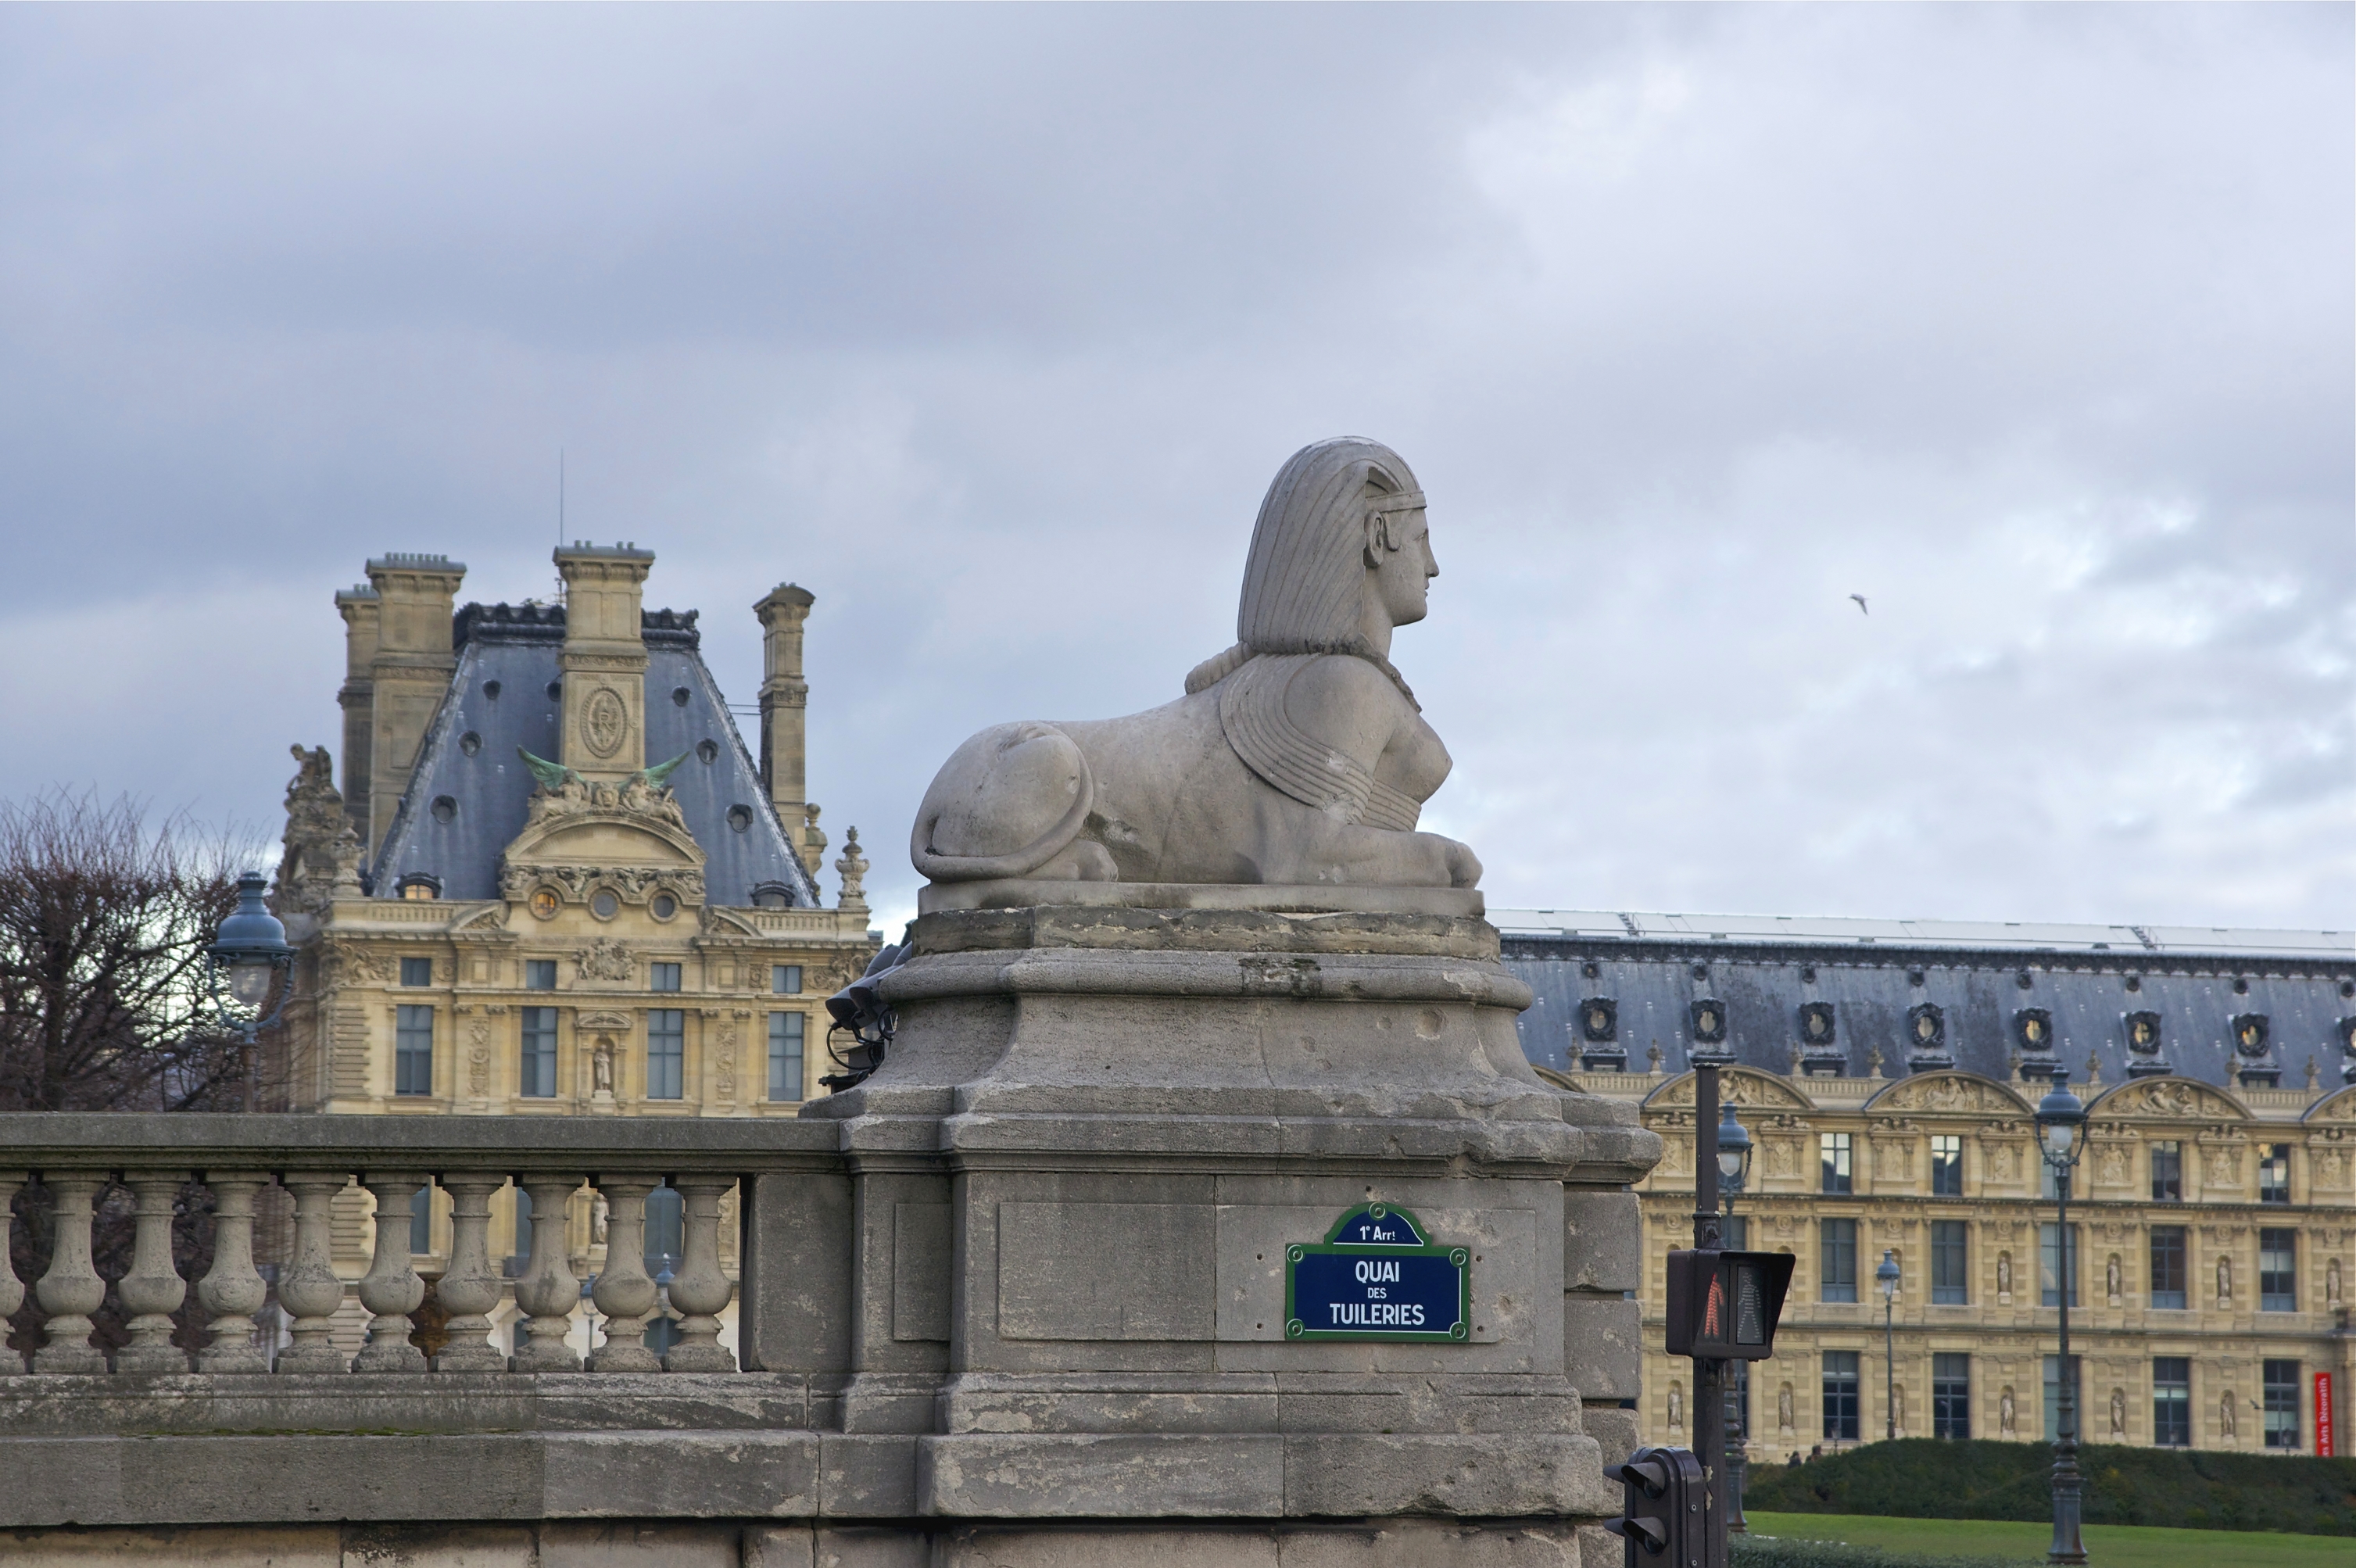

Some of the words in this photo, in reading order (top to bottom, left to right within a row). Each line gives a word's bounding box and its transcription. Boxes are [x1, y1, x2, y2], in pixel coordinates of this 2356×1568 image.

[1355, 1261, 1400, 1283] QUAI
[1367, 1287, 1387, 1299] DES
[1329, 1303, 1425, 1326] TUILERIES
[2318, 1377, 2329, 1423] Décoratifs
[2320, 1425, 2329, 1444] Arts
